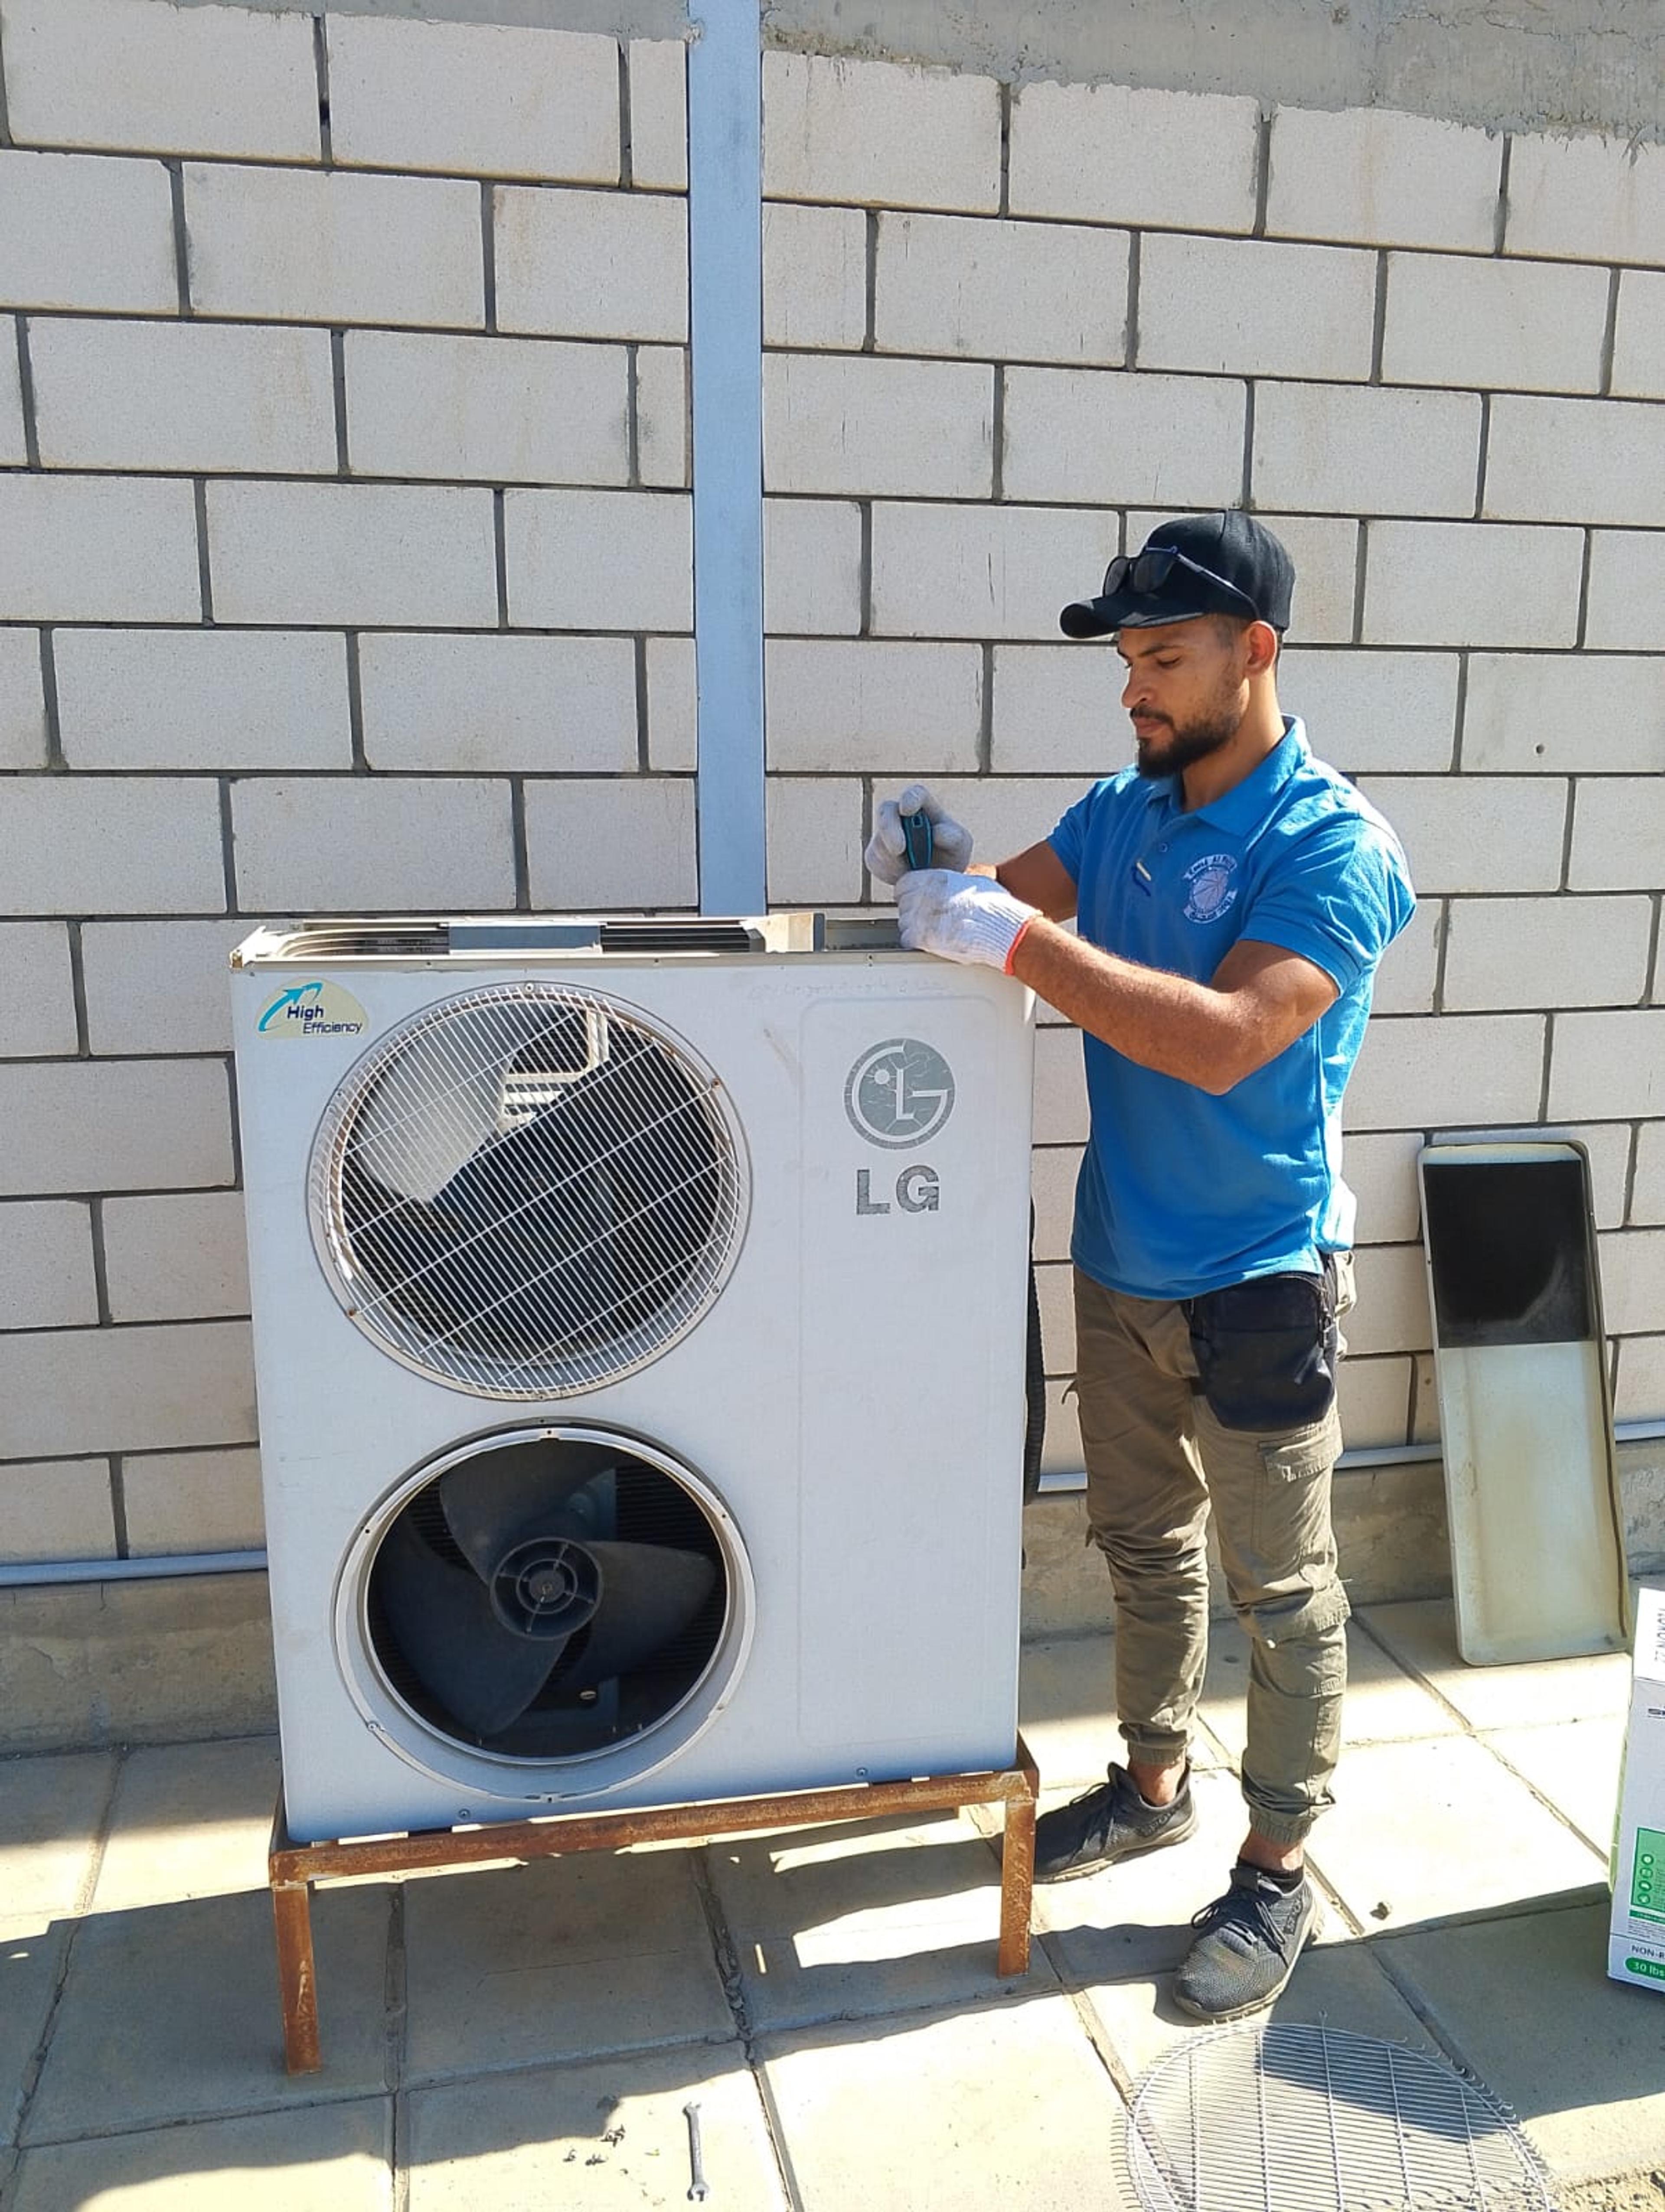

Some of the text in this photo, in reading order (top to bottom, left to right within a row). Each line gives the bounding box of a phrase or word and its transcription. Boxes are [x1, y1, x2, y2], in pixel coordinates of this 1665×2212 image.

[287, 1005, 323, 1021] High
[303, 1022, 362, 1034] Efficiency
[856, 1165, 940, 1215] LG
[1633, 1962, 1665, 1977] 30 lbs
